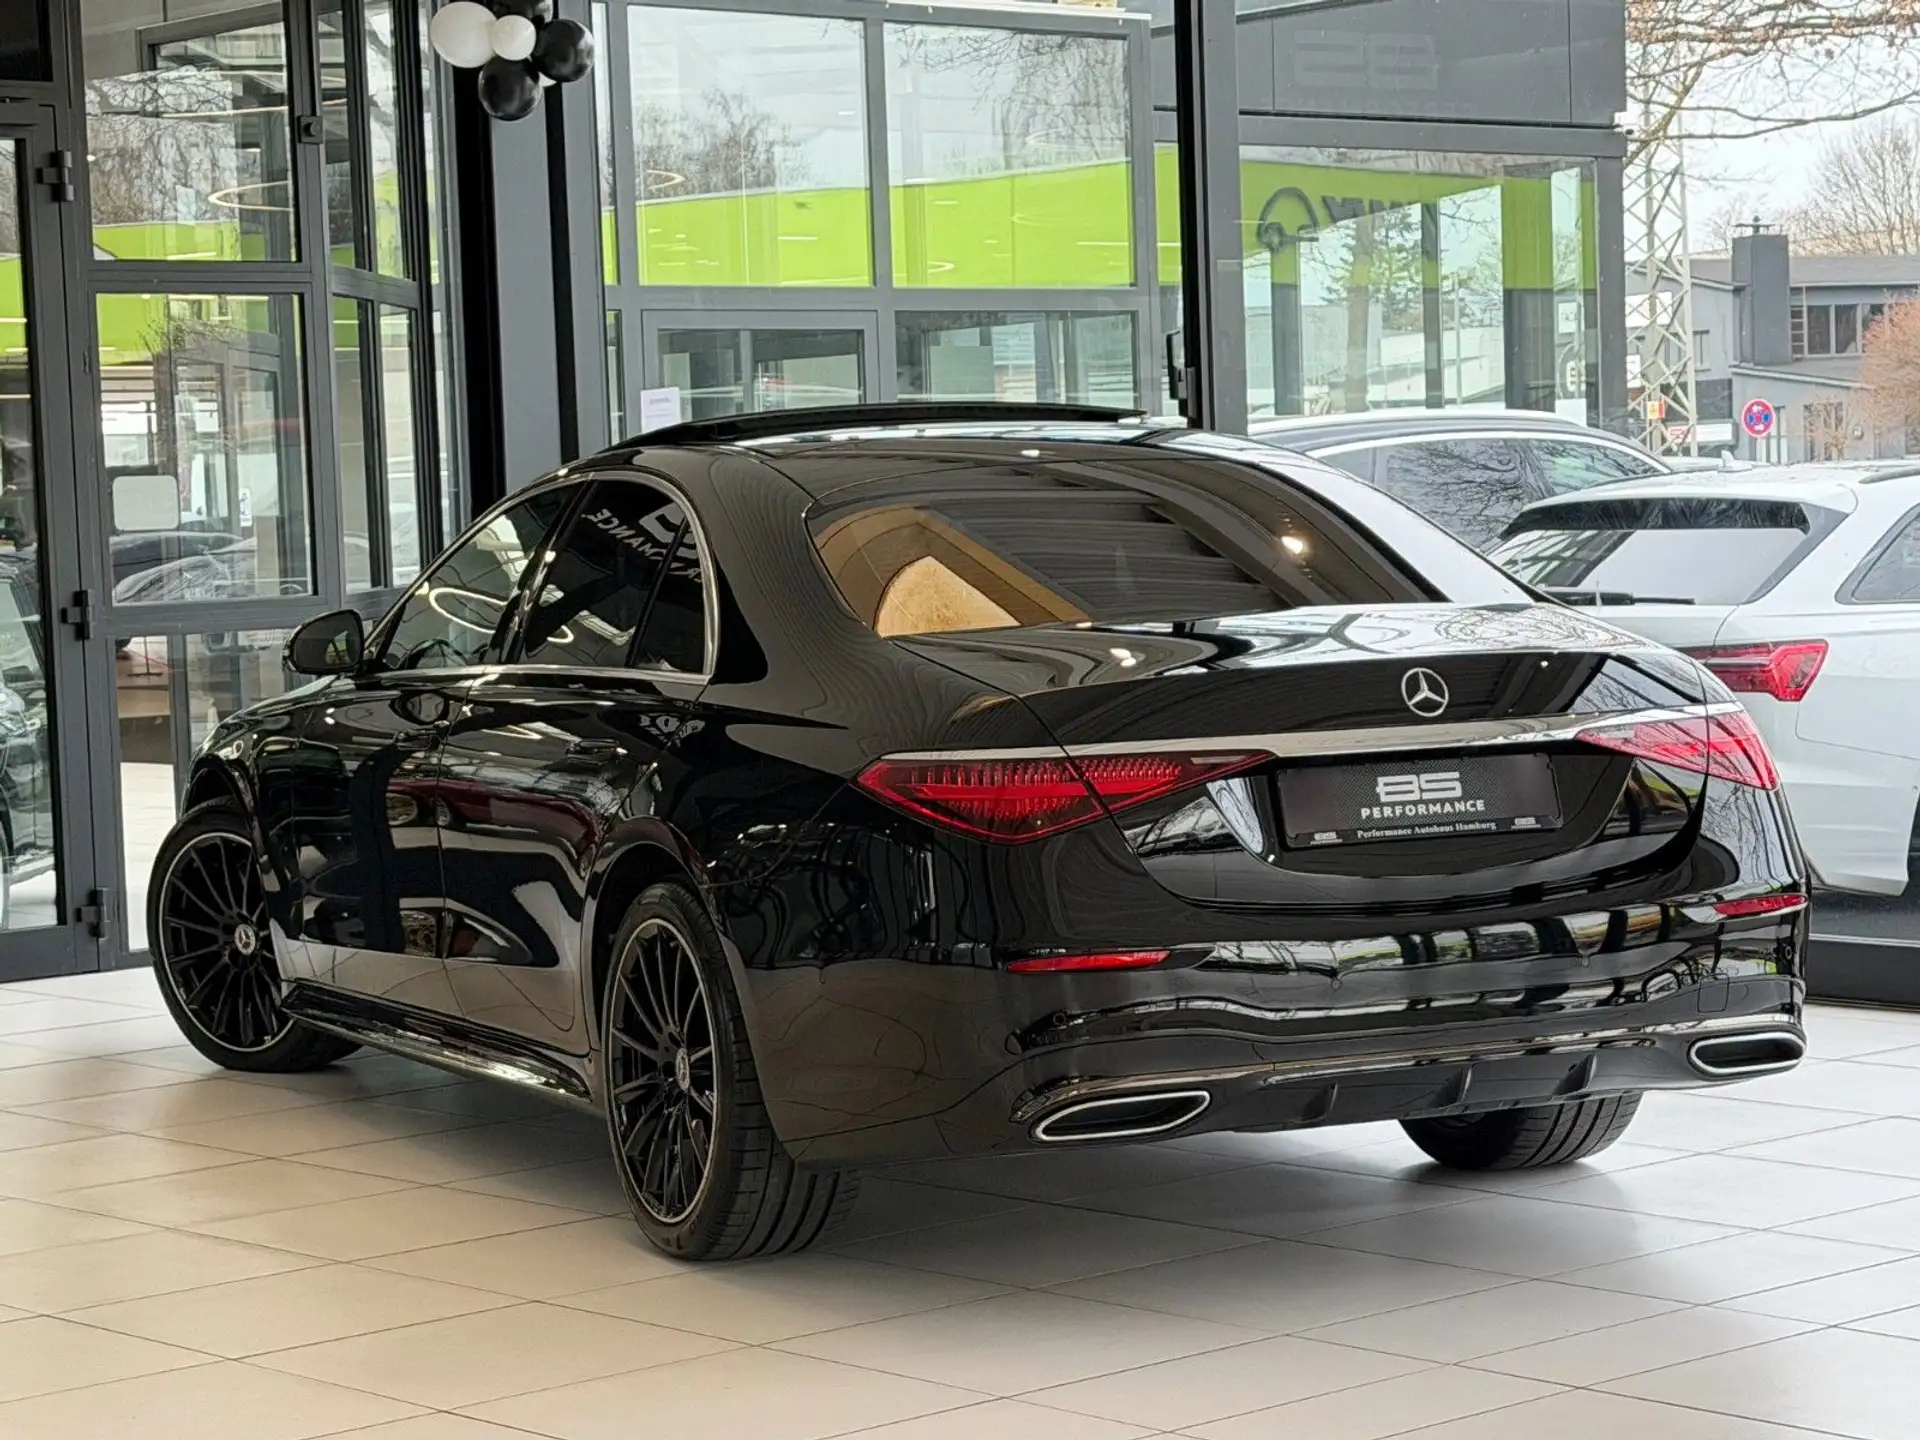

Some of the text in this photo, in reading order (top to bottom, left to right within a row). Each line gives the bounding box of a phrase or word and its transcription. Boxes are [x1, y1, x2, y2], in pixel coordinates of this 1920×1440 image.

[1360, 799, 1486, 820] PERFORMANCE
[1357, 821, 1497, 839] Performance Autohaus Hamburg
